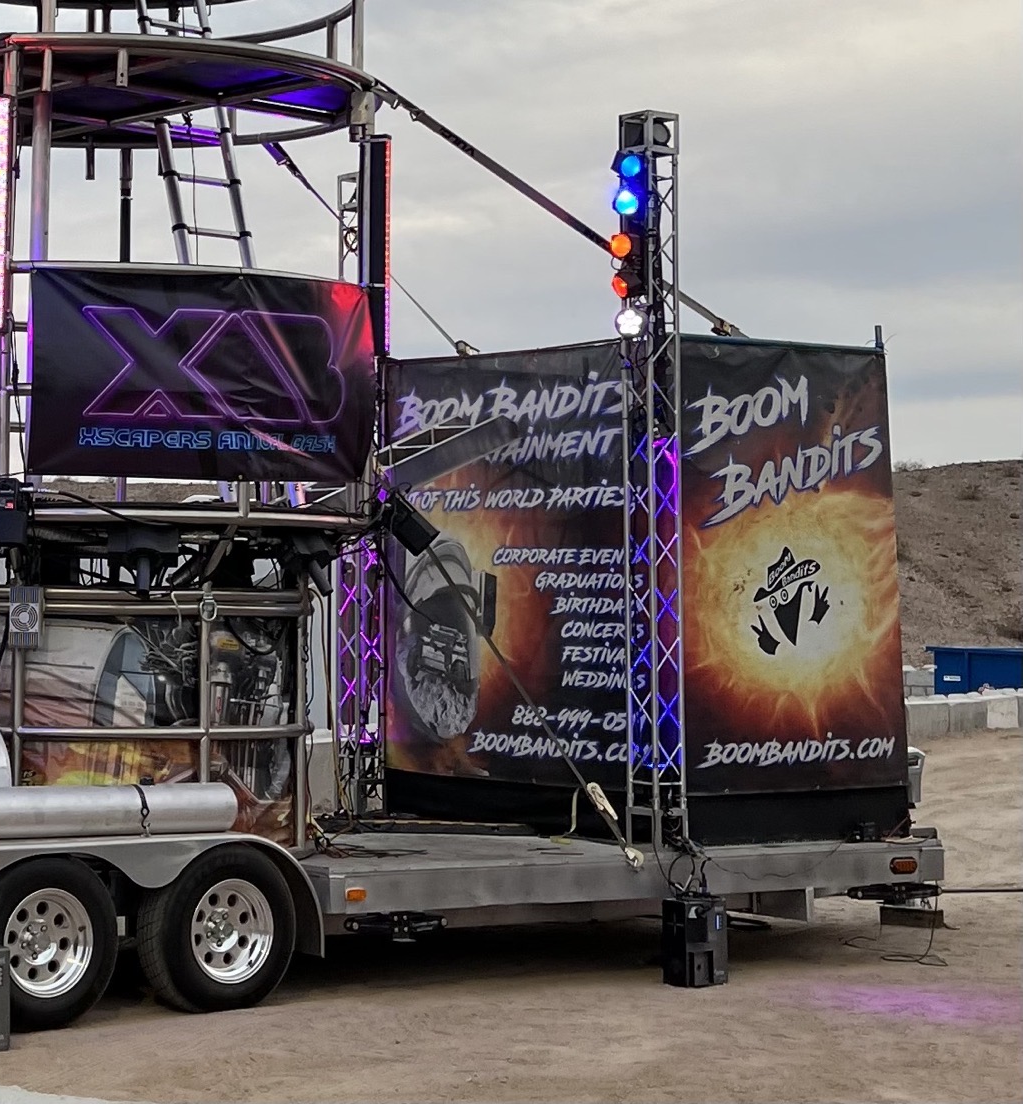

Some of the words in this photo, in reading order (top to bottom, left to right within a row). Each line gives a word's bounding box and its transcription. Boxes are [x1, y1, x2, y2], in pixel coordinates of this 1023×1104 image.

[392, 379, 482, 438] BOOM
[485, 371, 634, 426] BANDITS
[681, 374, 809, 459] BOOM
[79, 426, 211, 450] XSCAPERS
[700, 423, 883, 529] BANDITS
[420, 490, 441, 510] OF
[443, 483, 481, 511] THIS
[484, 487, 545, 509] WORLD
[492, 546, 576, 565] CORPORATE
[561, 620, 644, 640] CONCERS
[695, 730, 896, 770] BOOMBANDITS.COM
